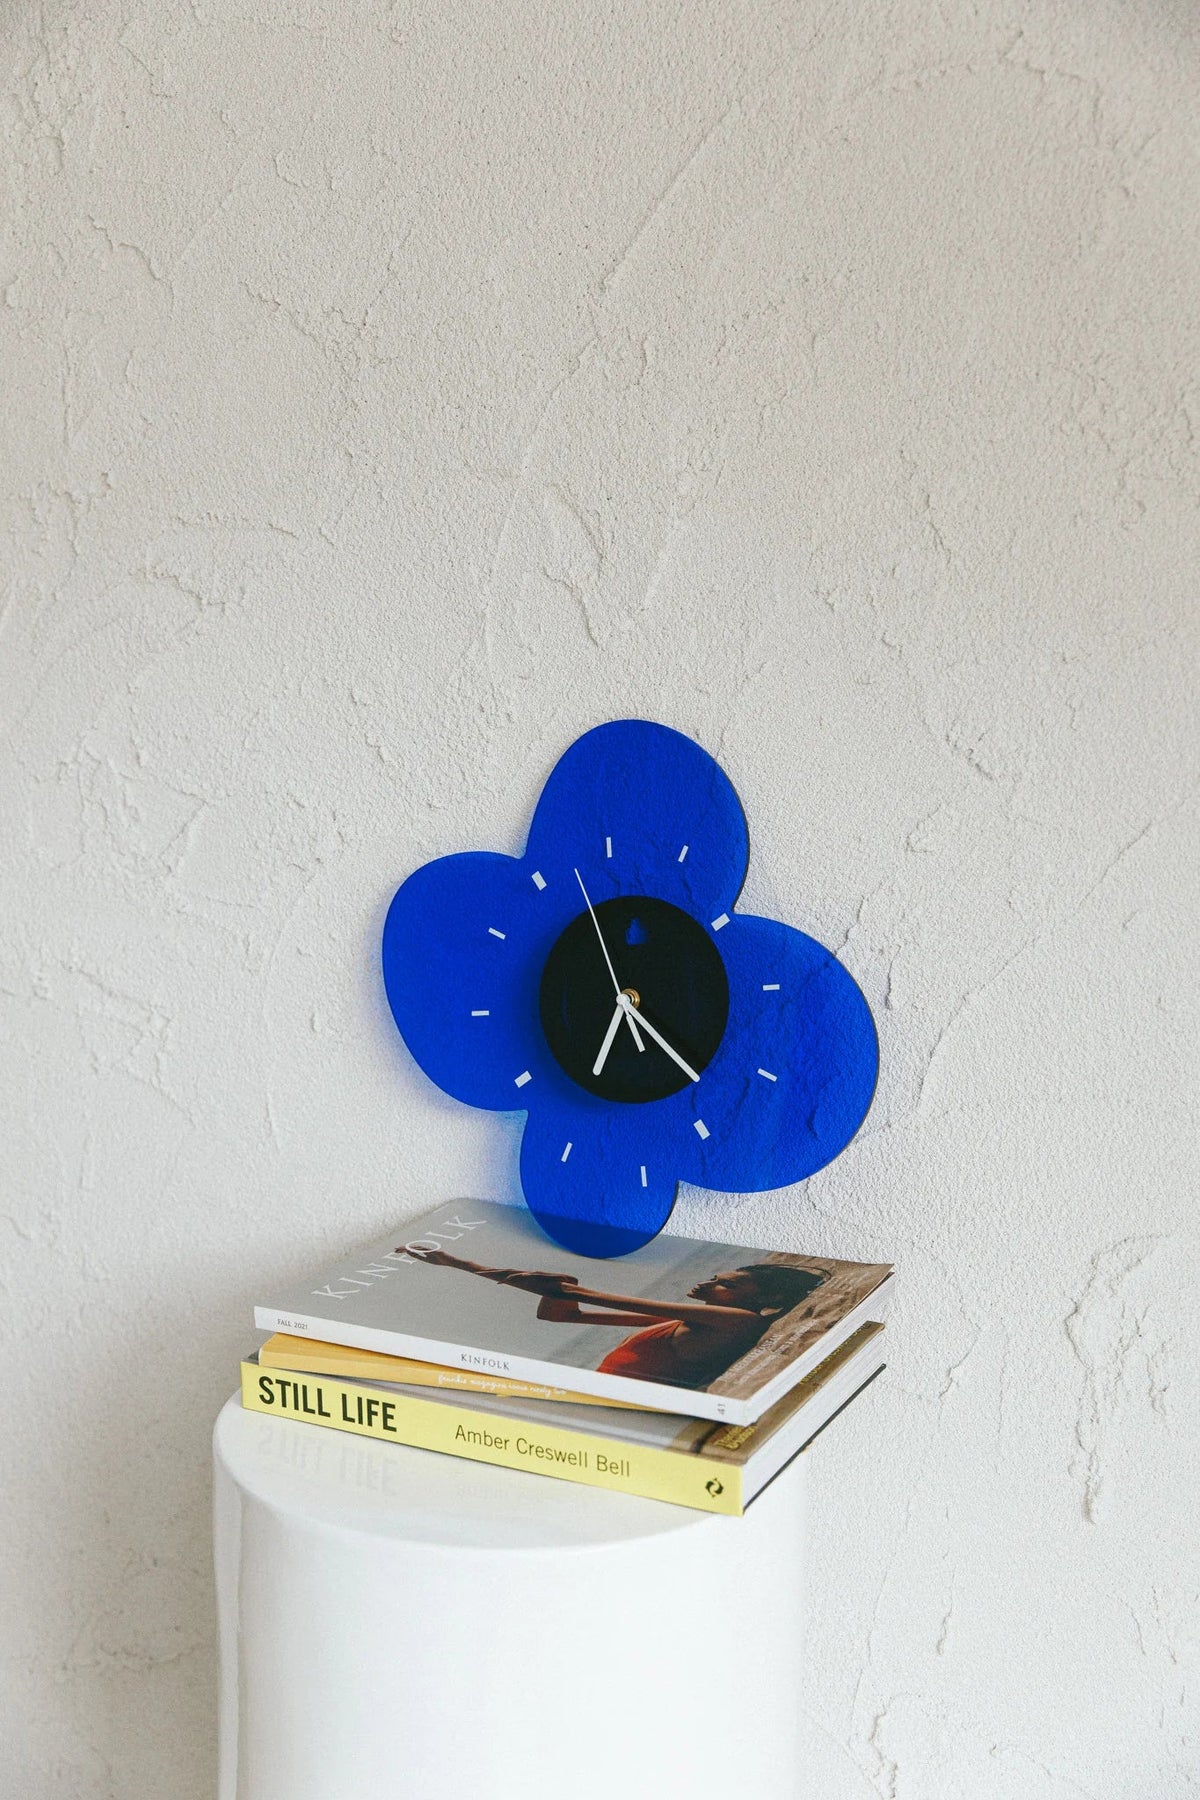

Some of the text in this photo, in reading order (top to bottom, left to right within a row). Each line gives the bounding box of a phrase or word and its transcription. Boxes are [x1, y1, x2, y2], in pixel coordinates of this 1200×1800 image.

[311, 1215, 487, 1300] KINFOLK
[277, 1318, 308, 1331] FALL 2021
[460, 1352, 510, 1371] KINFOLK
[258, 1375, 398, 1433] STILL LIFE
[455, 1424, 630, 1478] Amber Creswell Bell
